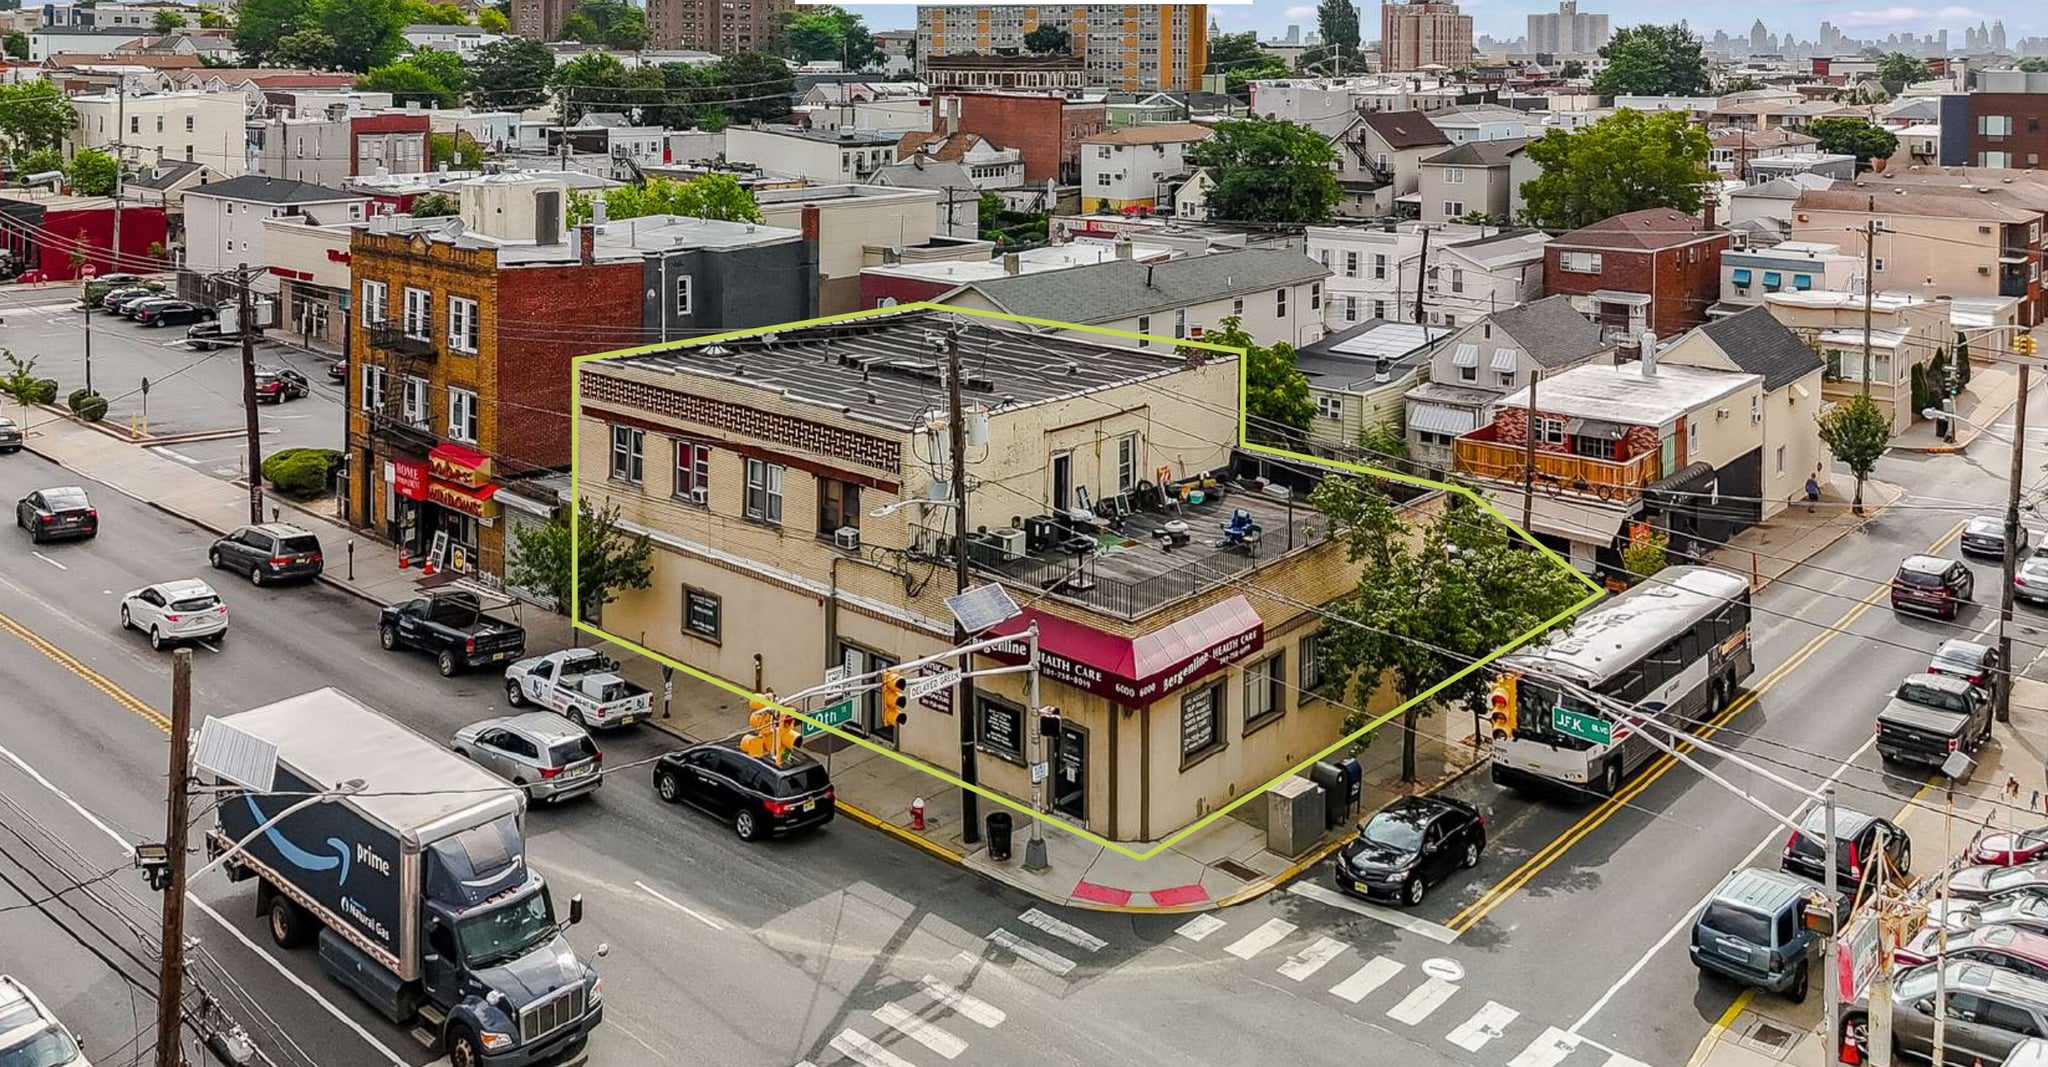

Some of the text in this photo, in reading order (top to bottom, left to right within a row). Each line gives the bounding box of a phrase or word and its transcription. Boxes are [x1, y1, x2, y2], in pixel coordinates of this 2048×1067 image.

[1075, 665, 1103, 682] CARE
[1163, 630, 1257, 692] Bergenline HEALTH CARE
[911, 679, 938, 697] DELAYED
[940, 672, 959, 685] GREEN
[1139, 682, 1156, 697] 6000
[1591, 723, 1609, 735] BLVD
[356, 842, 389, 876] prime
[350, 903, 375, 931] Natural
[376, 922, 389, 940] Gas
